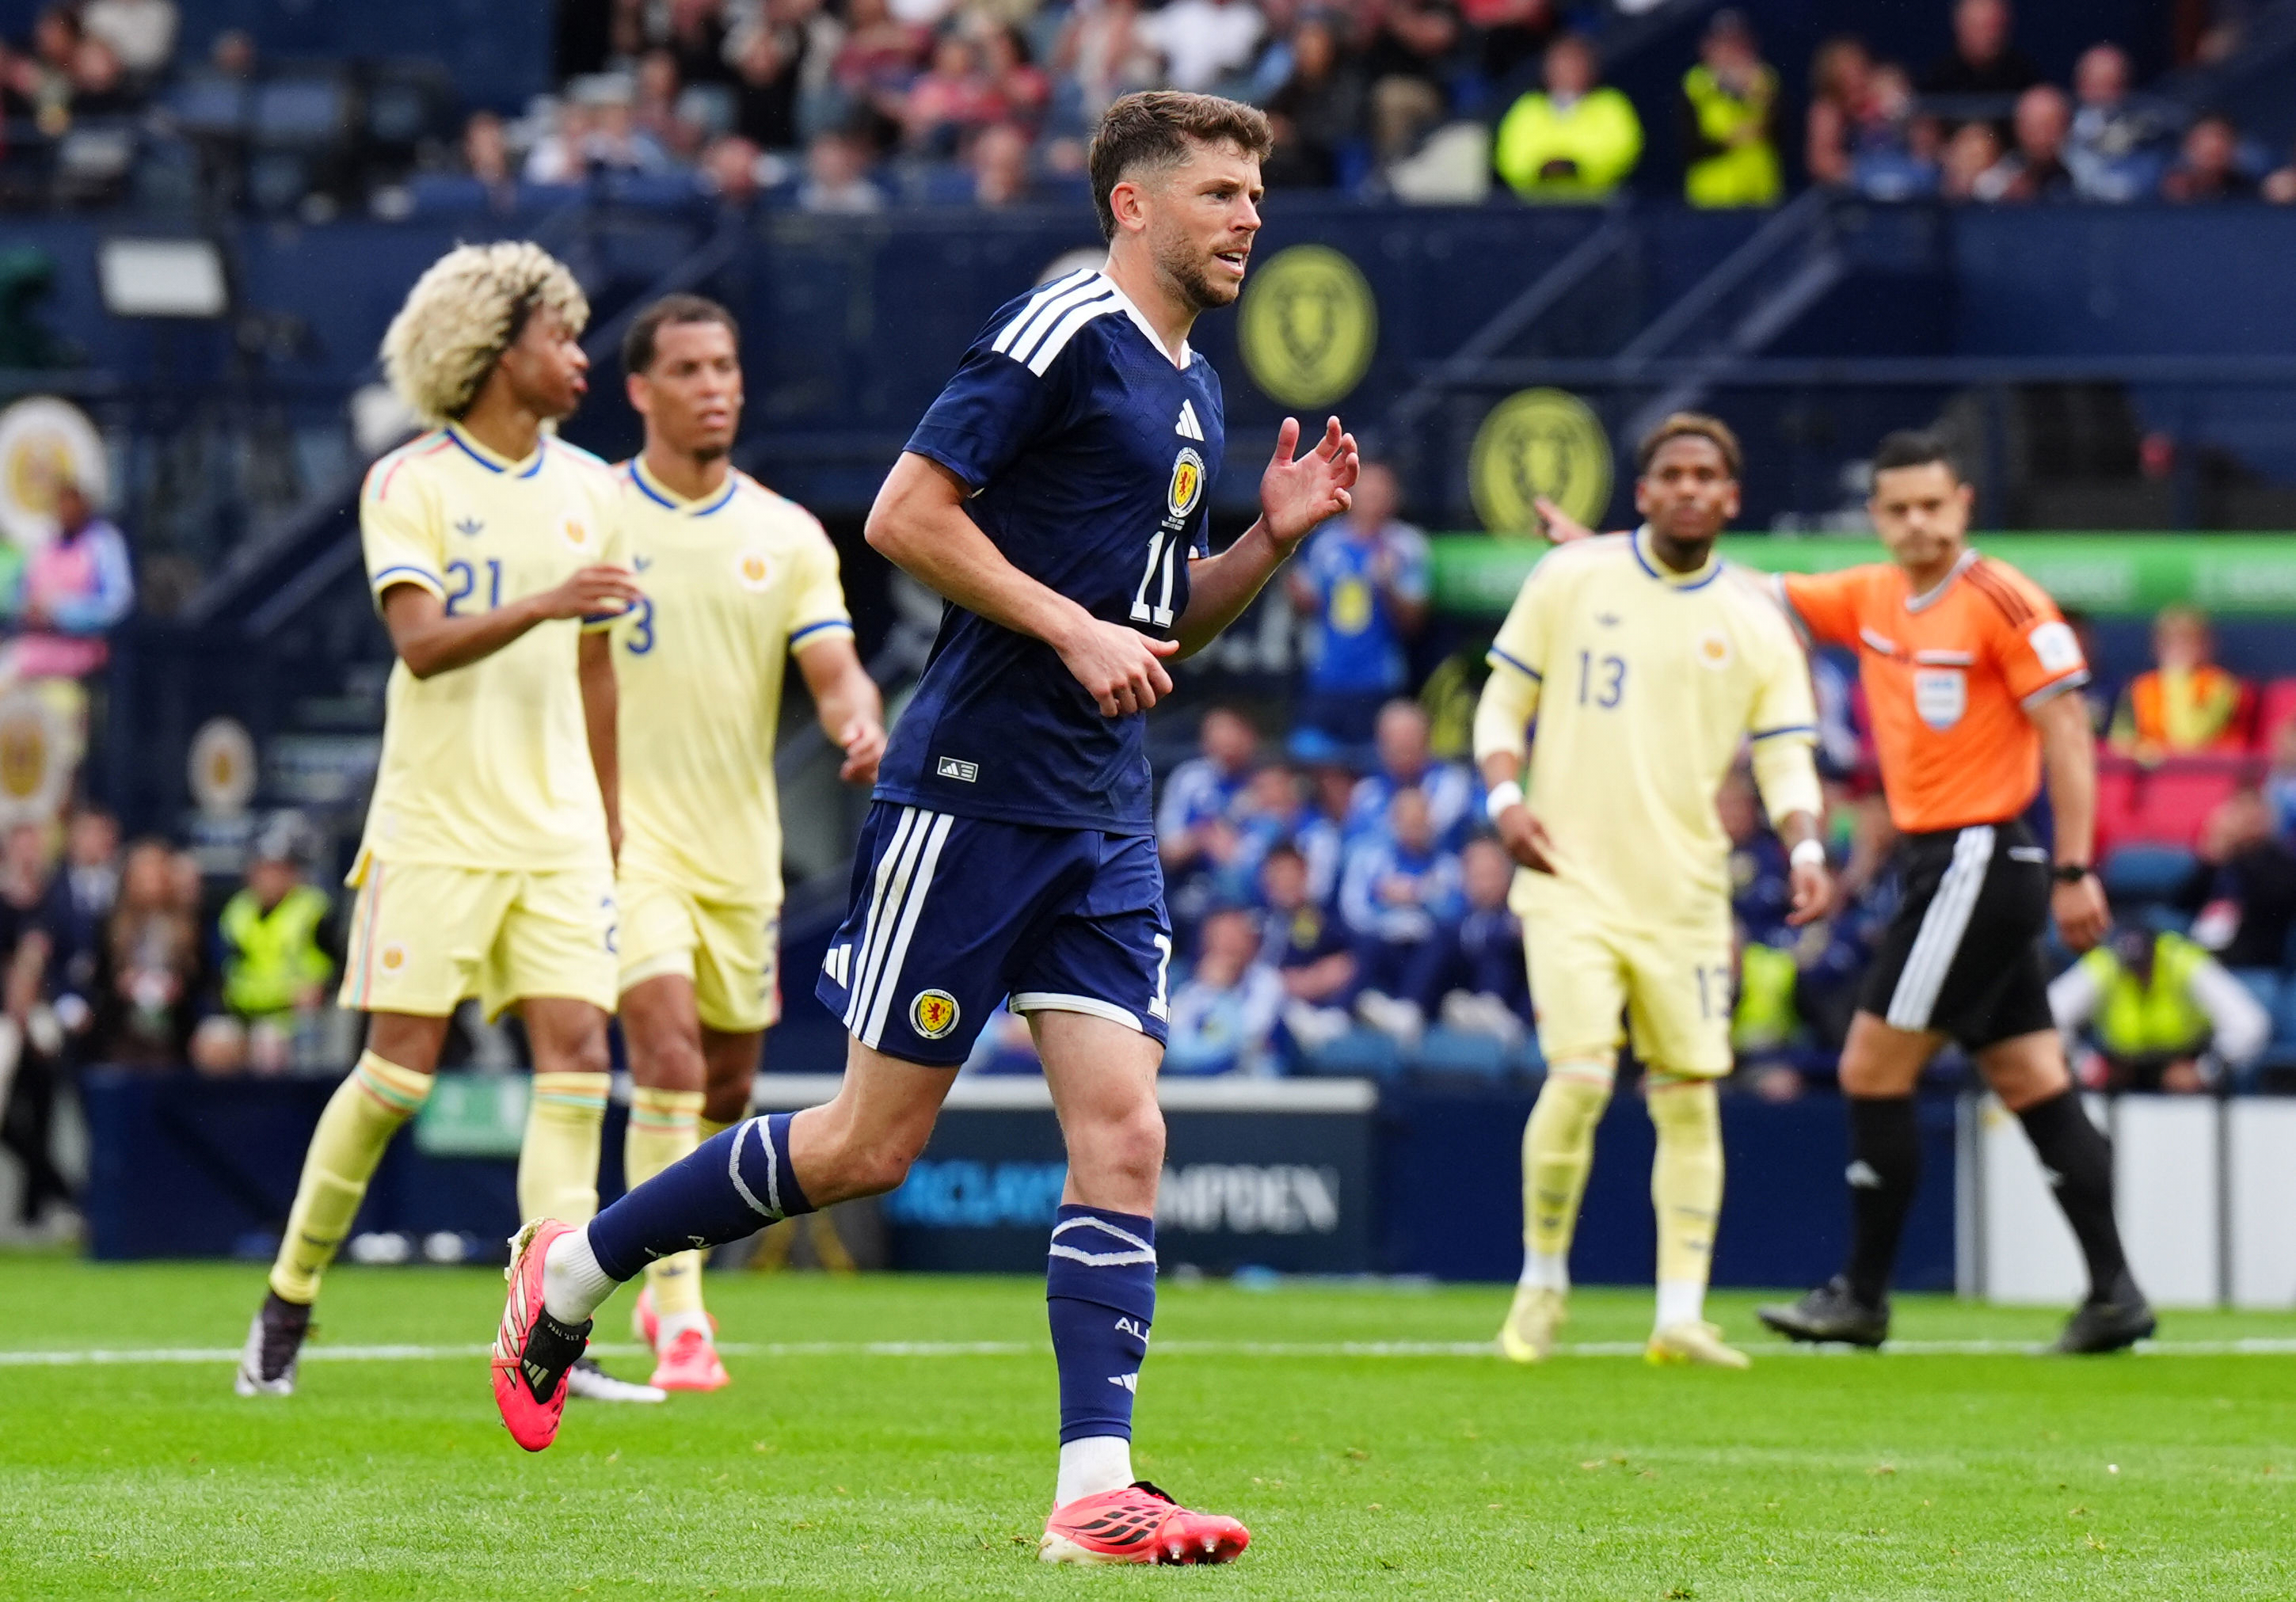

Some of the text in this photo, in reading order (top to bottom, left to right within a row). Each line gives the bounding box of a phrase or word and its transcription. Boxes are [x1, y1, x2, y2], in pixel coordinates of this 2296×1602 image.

[446, 560, 501, 616] 21
[1130, 531, 1177, 627] 11
[627, 598, 653, 654] 3
[1578, 650, 1627, 710] 13
[1149, 933, 1171, 1024] 1
